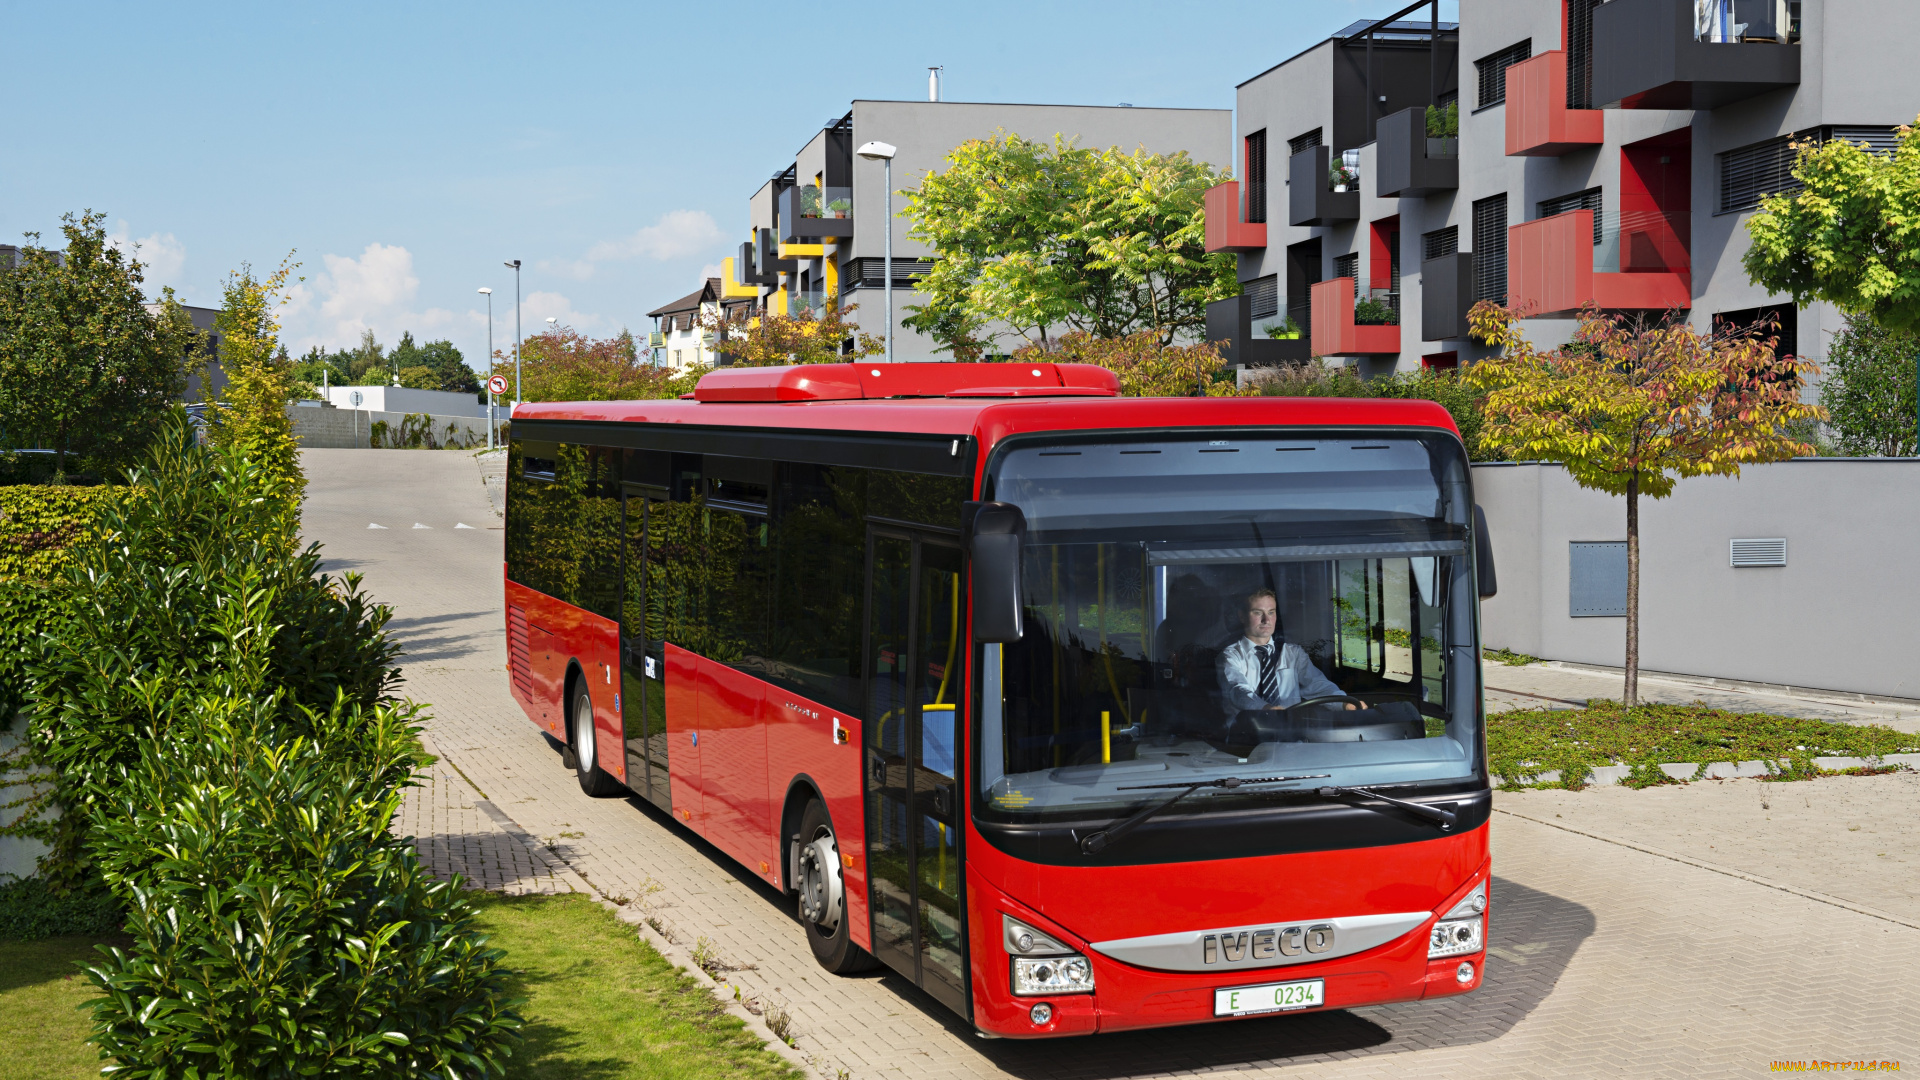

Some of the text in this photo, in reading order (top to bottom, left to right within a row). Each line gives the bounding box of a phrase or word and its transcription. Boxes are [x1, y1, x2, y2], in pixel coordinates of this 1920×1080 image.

[1203, 923, 1335, 965] IVECO
[1230, 984, 1315, 1010] E 0234
